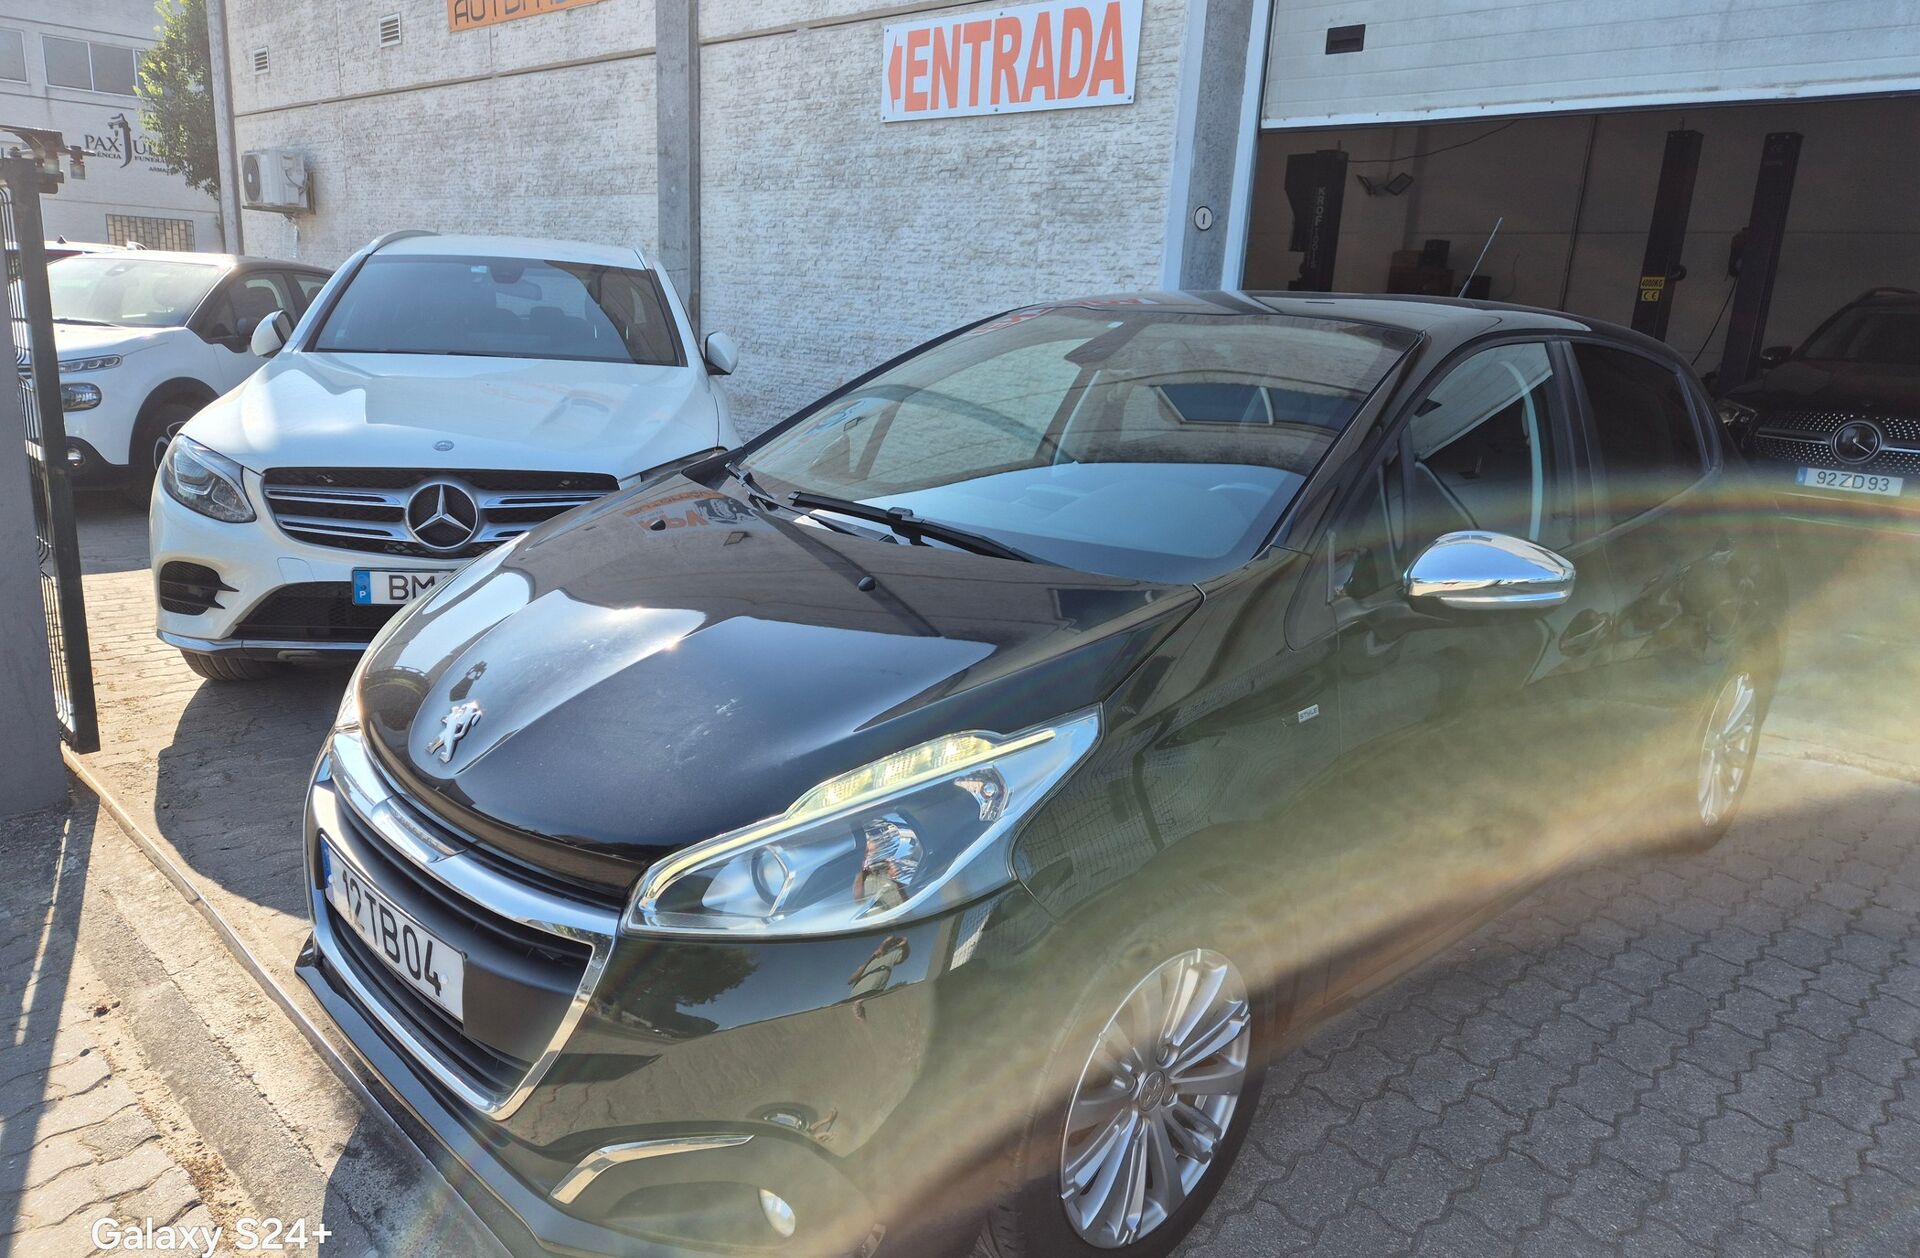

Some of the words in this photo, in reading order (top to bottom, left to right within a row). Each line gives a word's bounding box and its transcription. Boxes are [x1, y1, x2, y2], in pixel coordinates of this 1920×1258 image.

[904, 1, 1126, 112] ENTRADA
[96, 150, 122, 160] ÊNCIA
[1816, 470, 1890, 492] 92ZD93
[388, 574, 446, 601] BM
[342, 870, 442, 998] 12TB04
